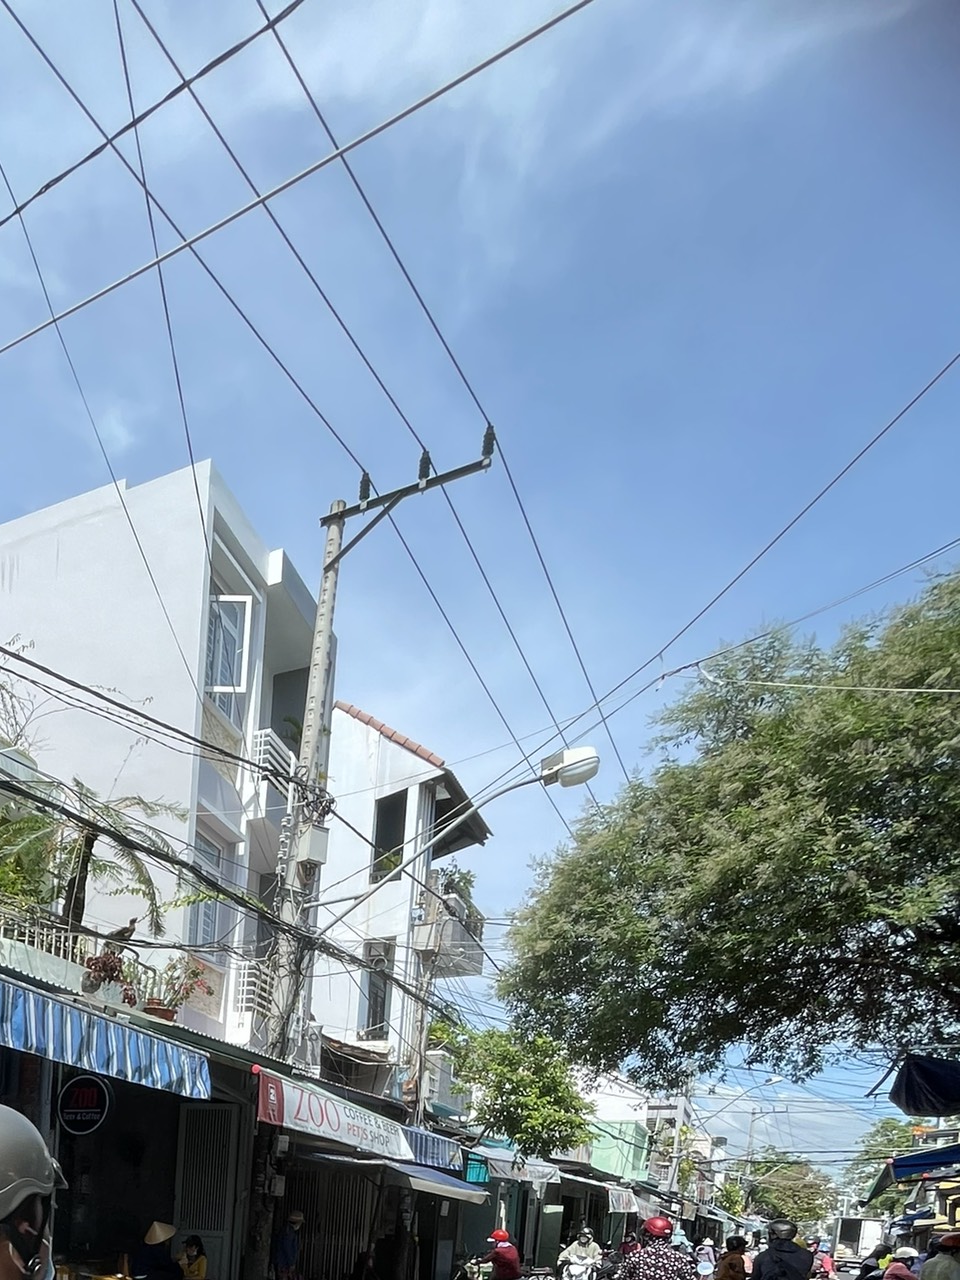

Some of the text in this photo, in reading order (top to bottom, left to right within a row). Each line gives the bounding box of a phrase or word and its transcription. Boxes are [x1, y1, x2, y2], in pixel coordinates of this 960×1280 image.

[292, 1086, 340, 1132] ZOO
[344, 1106, 373, 1126] COFFEE
[370, 1131, 390, 1147] SHOP
